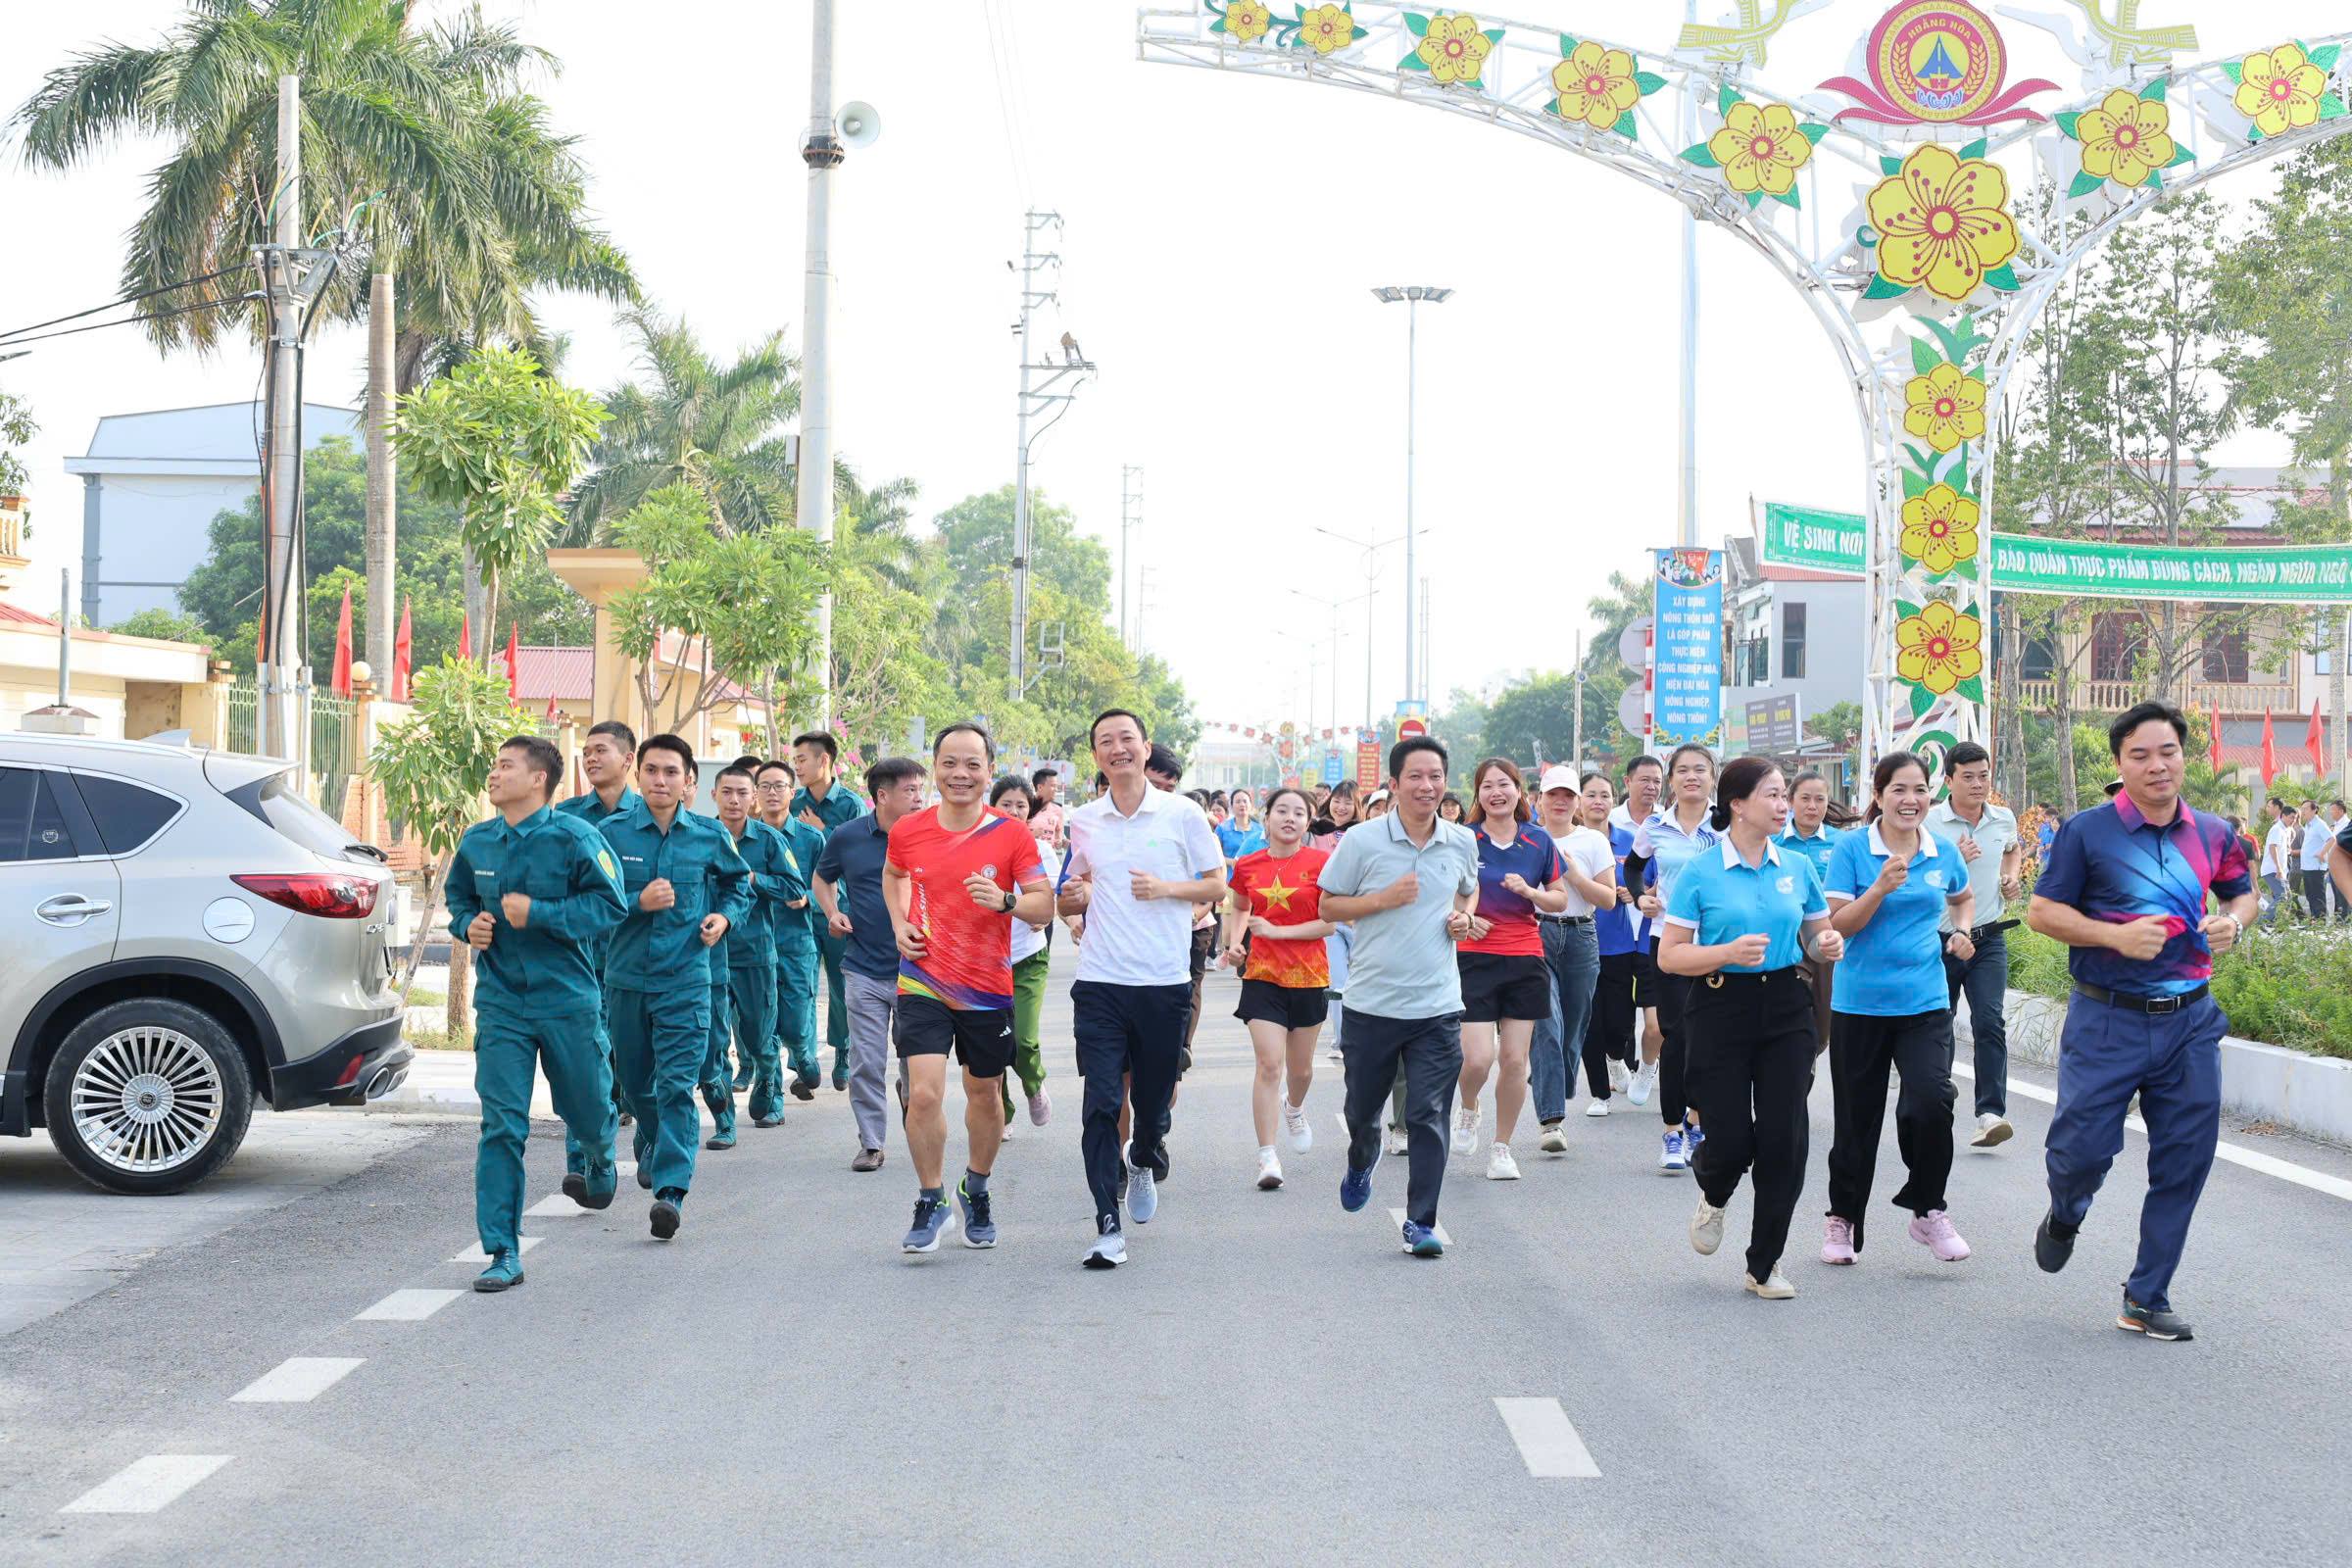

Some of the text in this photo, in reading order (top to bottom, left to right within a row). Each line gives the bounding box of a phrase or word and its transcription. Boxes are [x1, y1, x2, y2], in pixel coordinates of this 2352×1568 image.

[1784, 518, 1864, 557] VỆ SINH NƠI
[1997, 544, 2349, 589] BẢO QUẢN THỰC PHẨM ĐÚNG CÁCH, NGĂN NGỪA NGỘ
[1673, 595, 1706, 610] XÂY DỰNG
[1662, 612, 1682, 623] NÔNG
[1683, 612, 1700, 624] THÔN
[1667, 628, 1676, 640] LÀ
[1677, 628, 1690, 641] GÓP
[1671, 646, 1688, 659] THỰC
[1657, 662, 1676, 674] CÔNG
[1664, 695, 1684, 707] NÔNG
[1667, 711, 1686, 723] NÔNG
